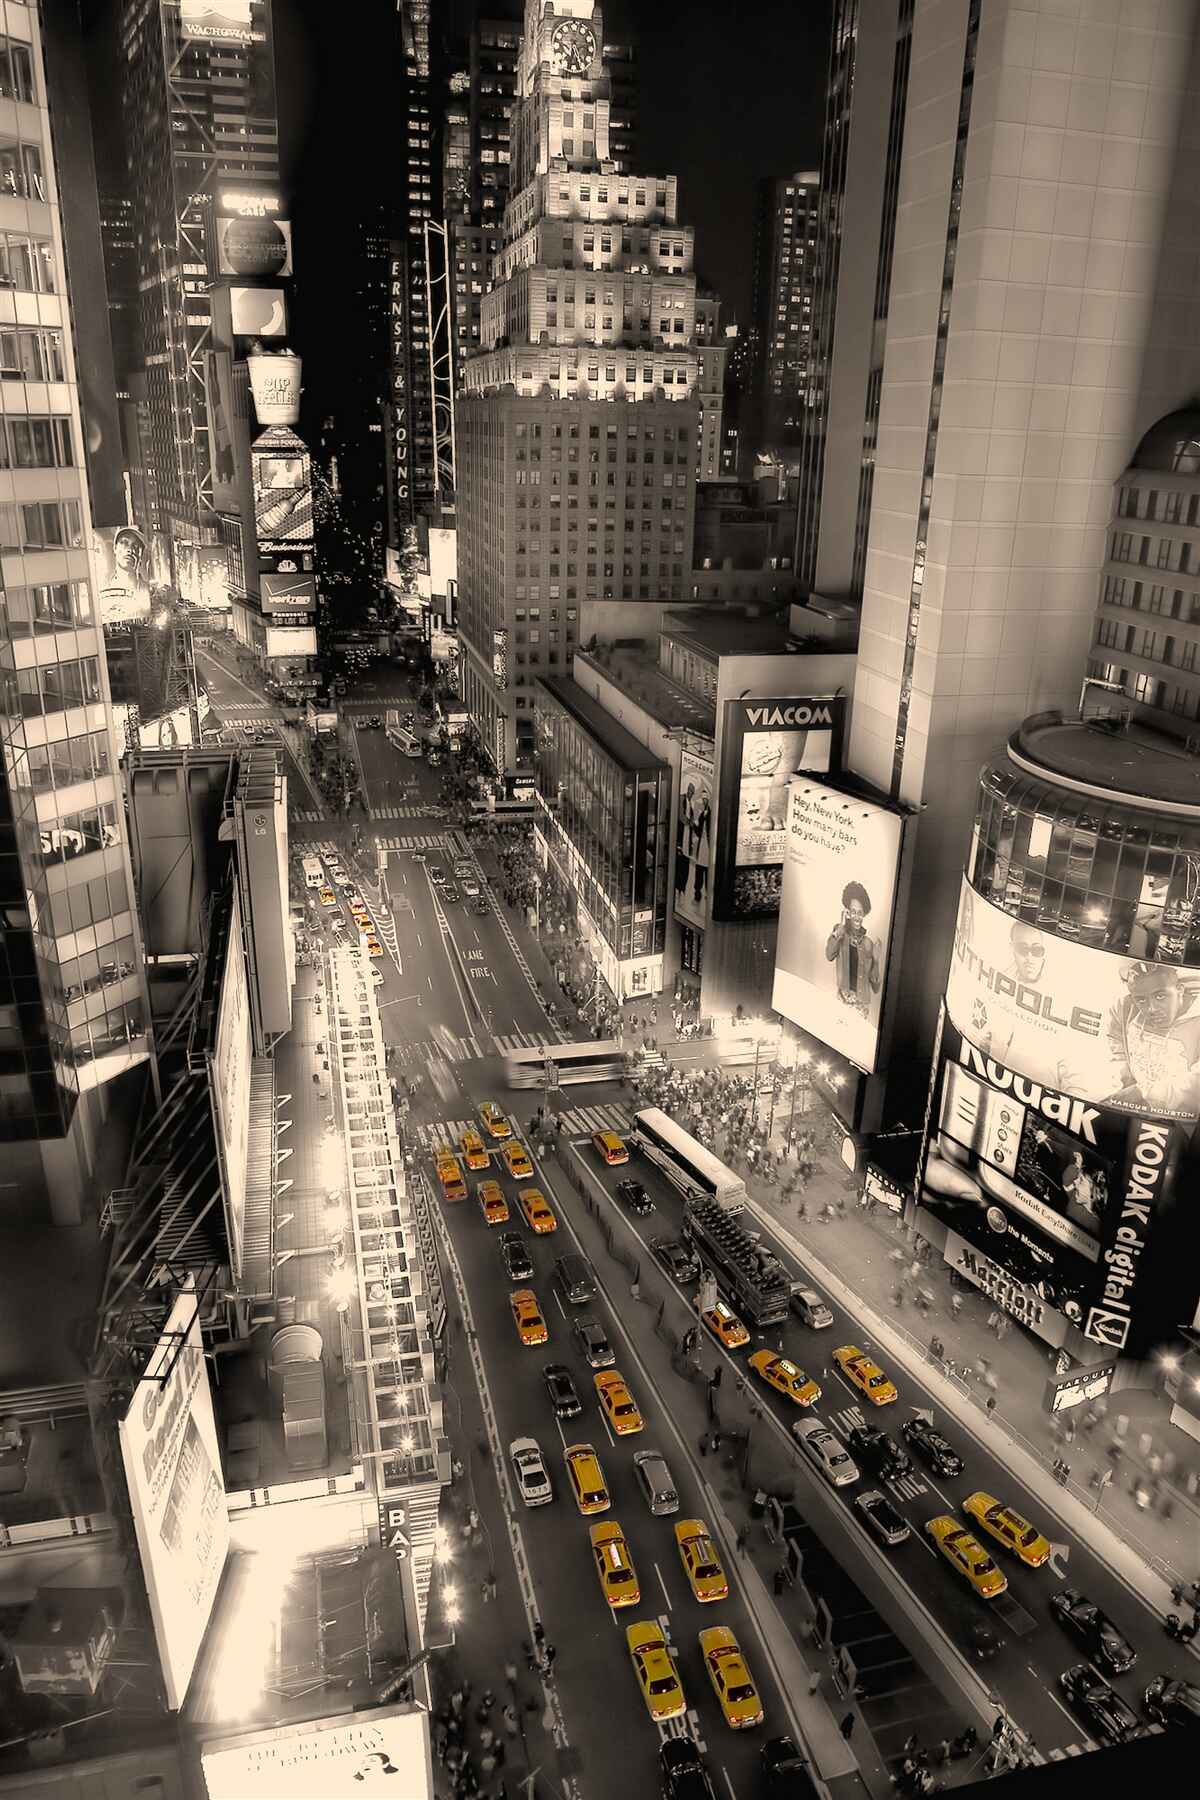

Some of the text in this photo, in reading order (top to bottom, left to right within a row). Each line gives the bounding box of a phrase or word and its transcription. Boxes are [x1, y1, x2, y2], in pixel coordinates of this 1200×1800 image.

[390, 261, 409, 499] ERNST & YOUNG
[745, 706, 833, 726] VIACOM
[813, 802, 833, 819] New
[791, 824, 803, 836] do
[804, 831, 819, 844] you
[792, 809, 858, 846] How many bars
[462, 950, 485, 960] LANE
[470, 967, 491, 979] FIRE
[1110, 1098, 1195, 1119] MARCUS HOUSTON
[1015, 1190, 1042, 1214] Kodak
[1103, 1122, 1169, 1312] KODAK digital
[1007, 1224, 1020, 1239] the
[1020, 1233, 1055, 1264] Moments
[957, 1248, 1044, 1324] Marriott
[1056, 1367, 1113, 1391] MARQUIS
